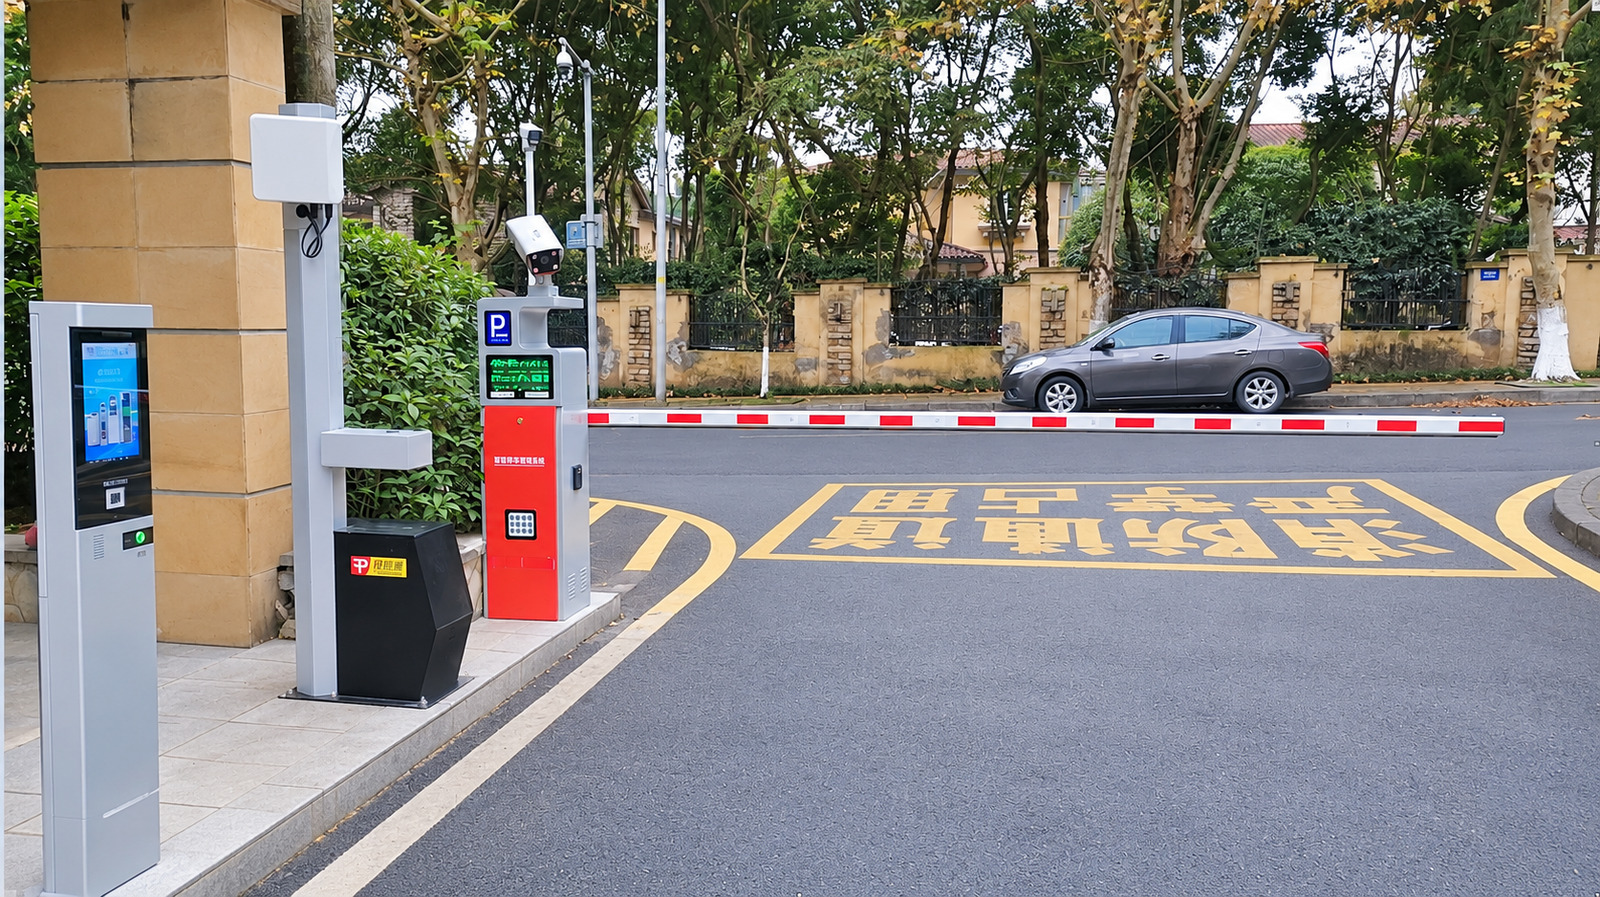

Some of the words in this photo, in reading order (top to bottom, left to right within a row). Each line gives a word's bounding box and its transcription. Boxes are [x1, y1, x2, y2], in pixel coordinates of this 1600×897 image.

[490, 314, 506, 338] P
[807, 518, 1455, 562] 消防通道
